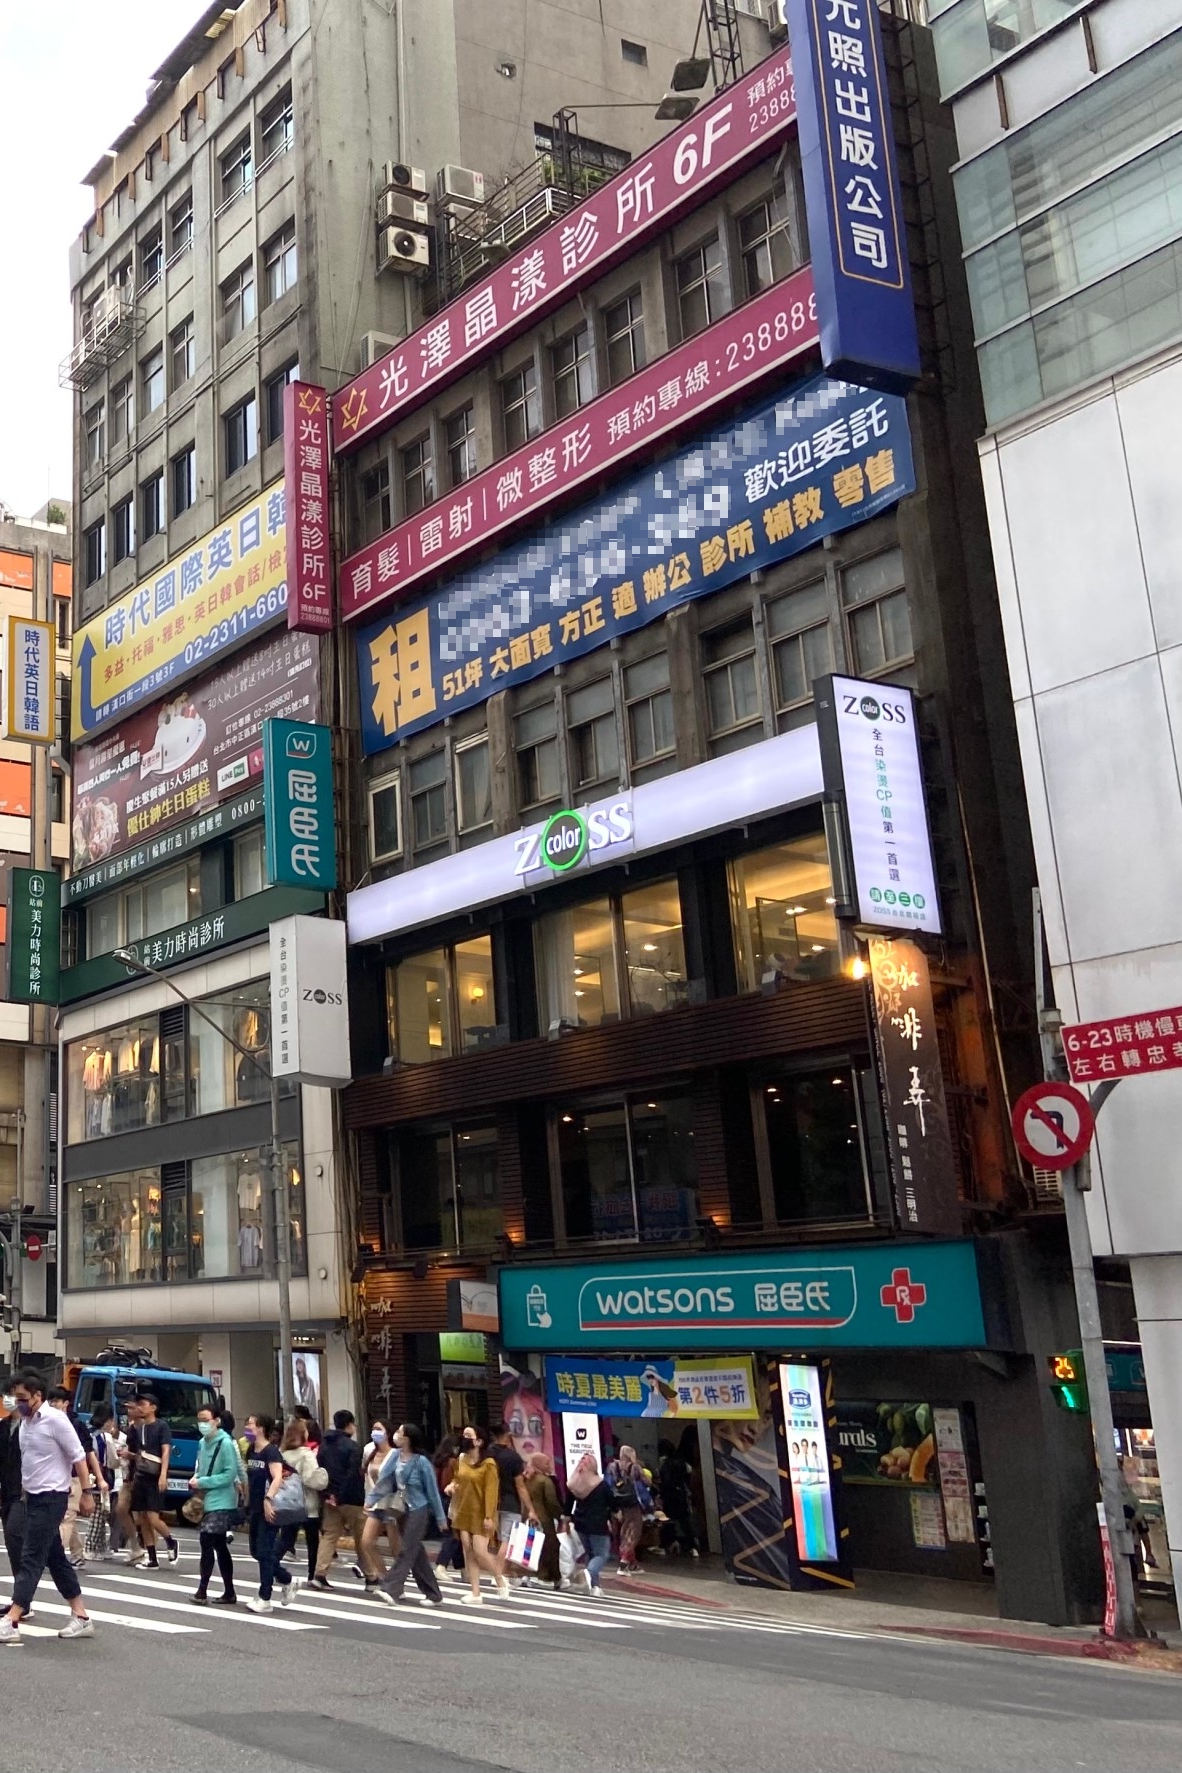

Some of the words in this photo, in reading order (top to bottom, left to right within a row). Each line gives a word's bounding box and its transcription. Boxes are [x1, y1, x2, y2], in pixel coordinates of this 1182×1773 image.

[378, 162, 656, 409] 光澤晶漾診所
[673, 103, 733, 186] 6F
[299, 419, 324, 579] 光澤晶漾診所
[744, 397, 889, 505] 歡迎委託
[351, 543, 400, 600] 育髮
[419, 496, 473, 558] 雷射
[496, 423, 594, 513] 微整形
[302, 583, 327, 601] 6F
[442, 657, 484, 701] 51坪
[489, 622, 554, 680] 大面寬
[559, 596, 606, 646] 方正
[642, 552, 692, 602] 辦公
[700, 519, 755, 578] 診所
[763, 486, 825, 546] 補教
[832, 448, 896, 508] 零售
[23, 628, 40, 732] 時代英日韓語
[369, 606, 438, 738] 租
[221, 768, 233, 782] LINE
[288, 769, 321, 878] 屈臣氏
[872, 727, 901, 882] 全台染燙CP值第一首選
[546, 828, 582, 858] color
[29, 908, 44, 996] 美力時尚診所
[151, 914, 226, 965] 美力時尚診所
[596, 1281, 735, 1316] watsons
[754, 1281, 830, 1312] 屈臣氏
[555, 1371, 643, 1403] 時夏最美麗
[678, 1384, 746, 1405] 第2件5折
